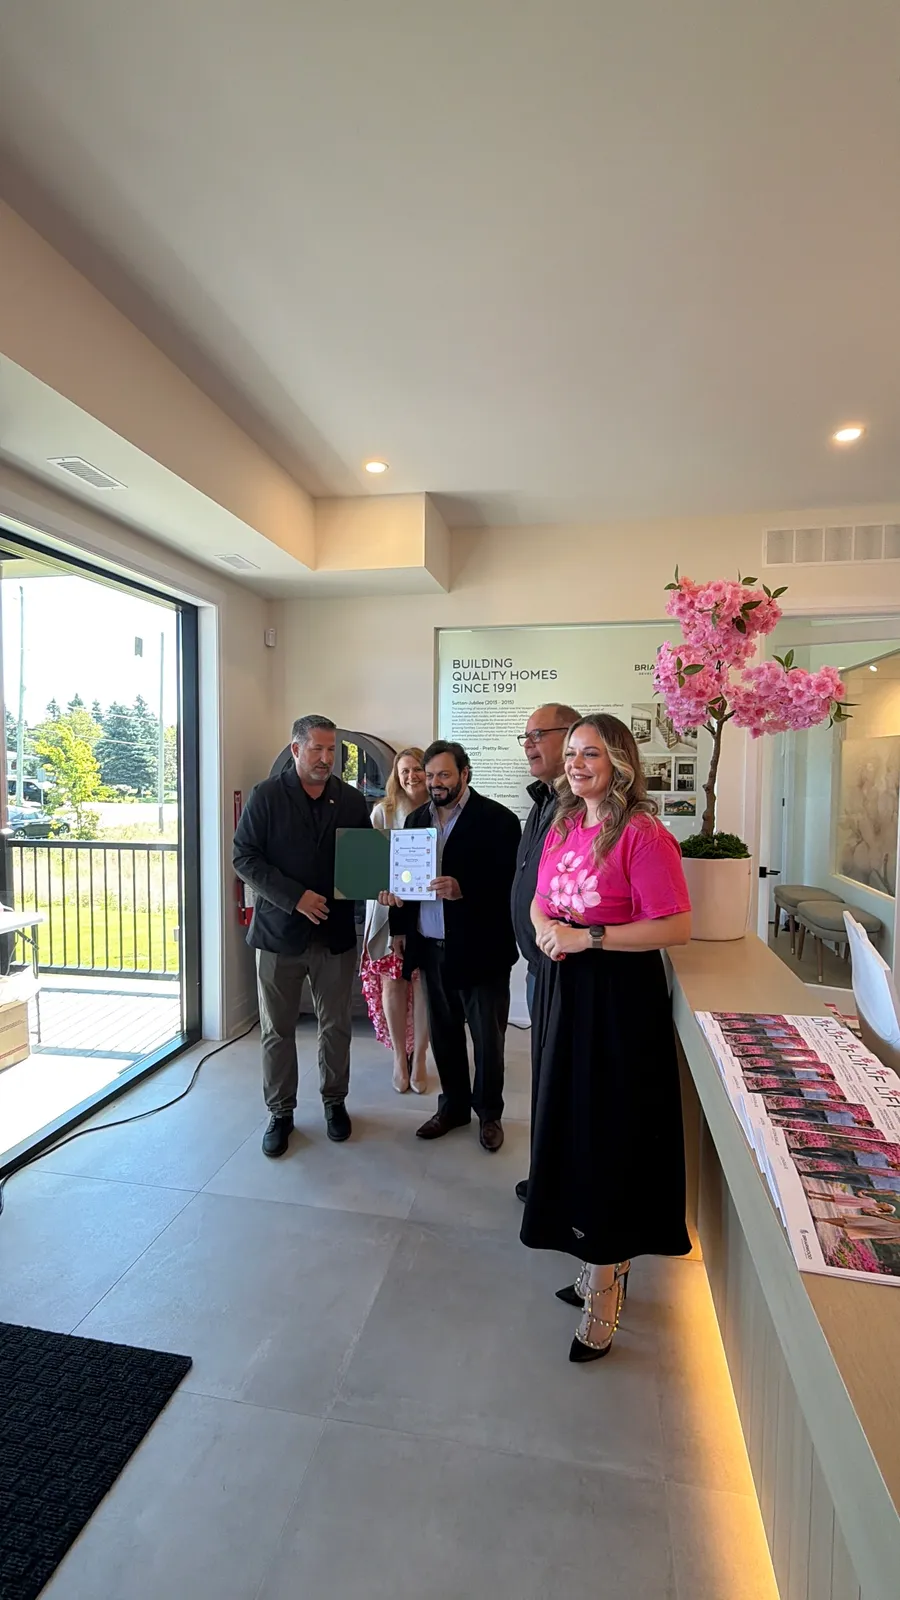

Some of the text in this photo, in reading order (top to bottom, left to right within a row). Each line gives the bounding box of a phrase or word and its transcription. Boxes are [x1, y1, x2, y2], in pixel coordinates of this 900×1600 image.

[452, 658, 513, 669] BUILDING
[452, 669, 558, 682] QUALITY HOMES
[452, 683, 517, 693] SINCE 1991
